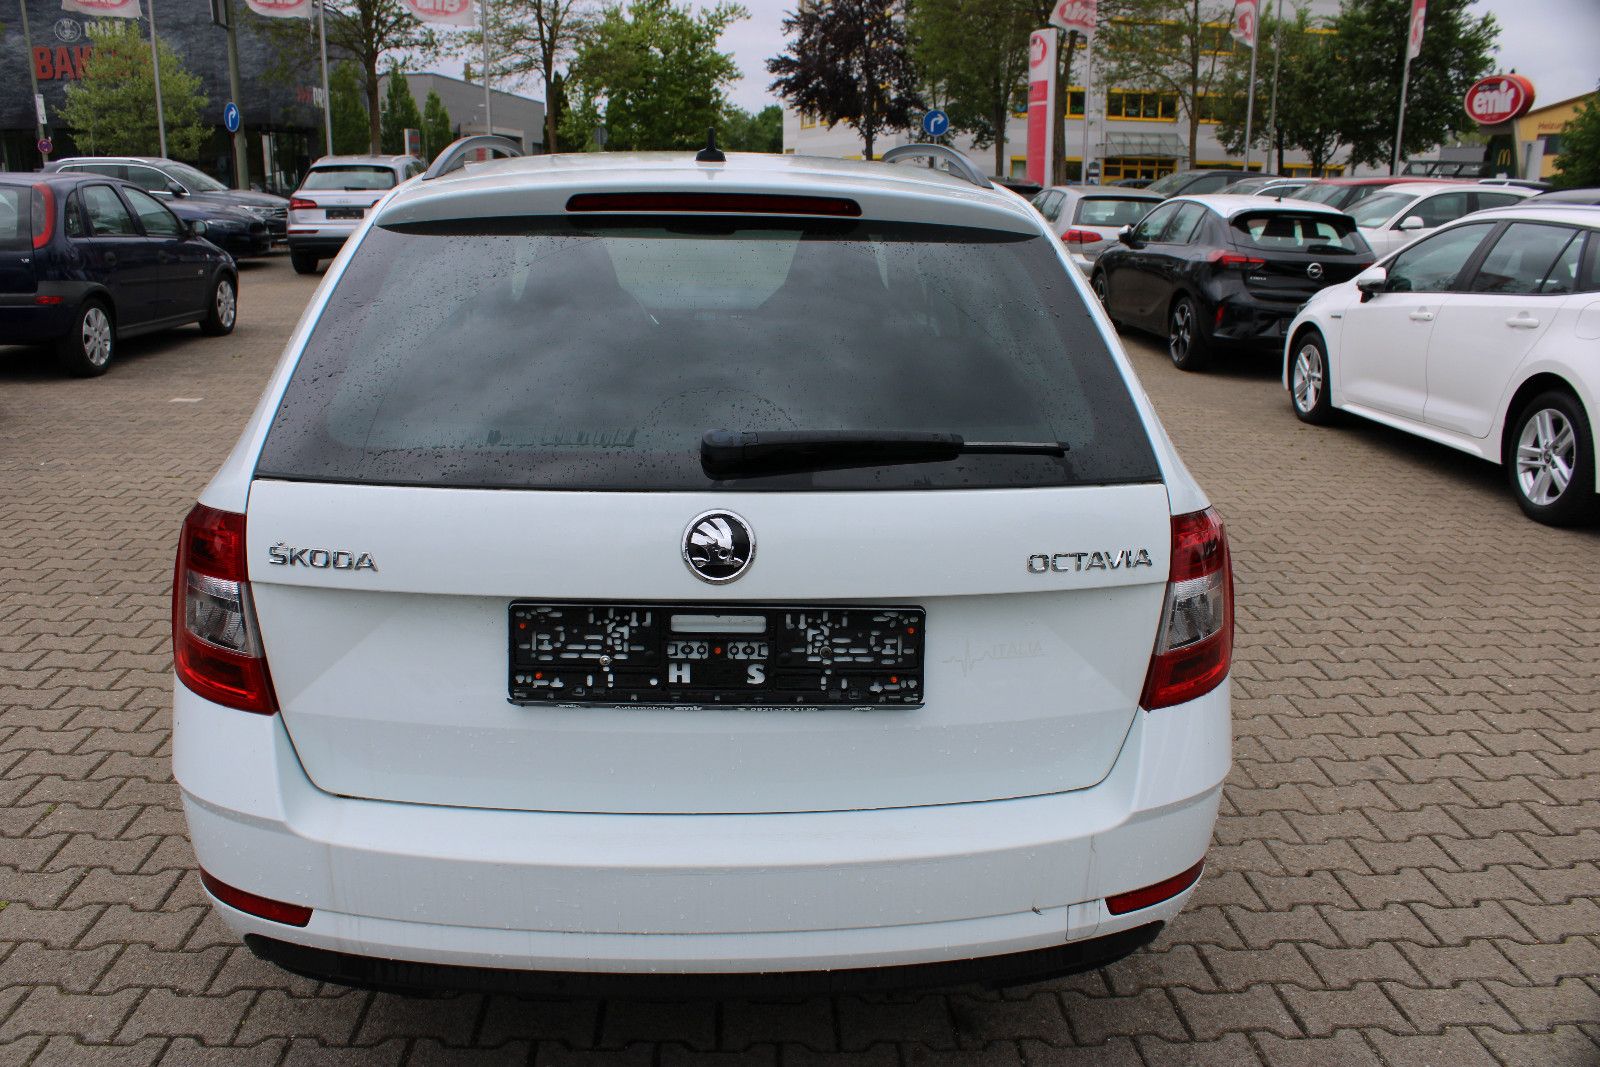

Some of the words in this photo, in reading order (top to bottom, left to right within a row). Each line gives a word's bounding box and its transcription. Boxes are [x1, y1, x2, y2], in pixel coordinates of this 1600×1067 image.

[32, 44, 110, 80] BAK
[1472, 80, 1515, 115] emir
[268, 542, 378, 572] ŠKODA
[1027, 549, 1153, 573] OCTAVIA
[746, 663, 766, 684] S
